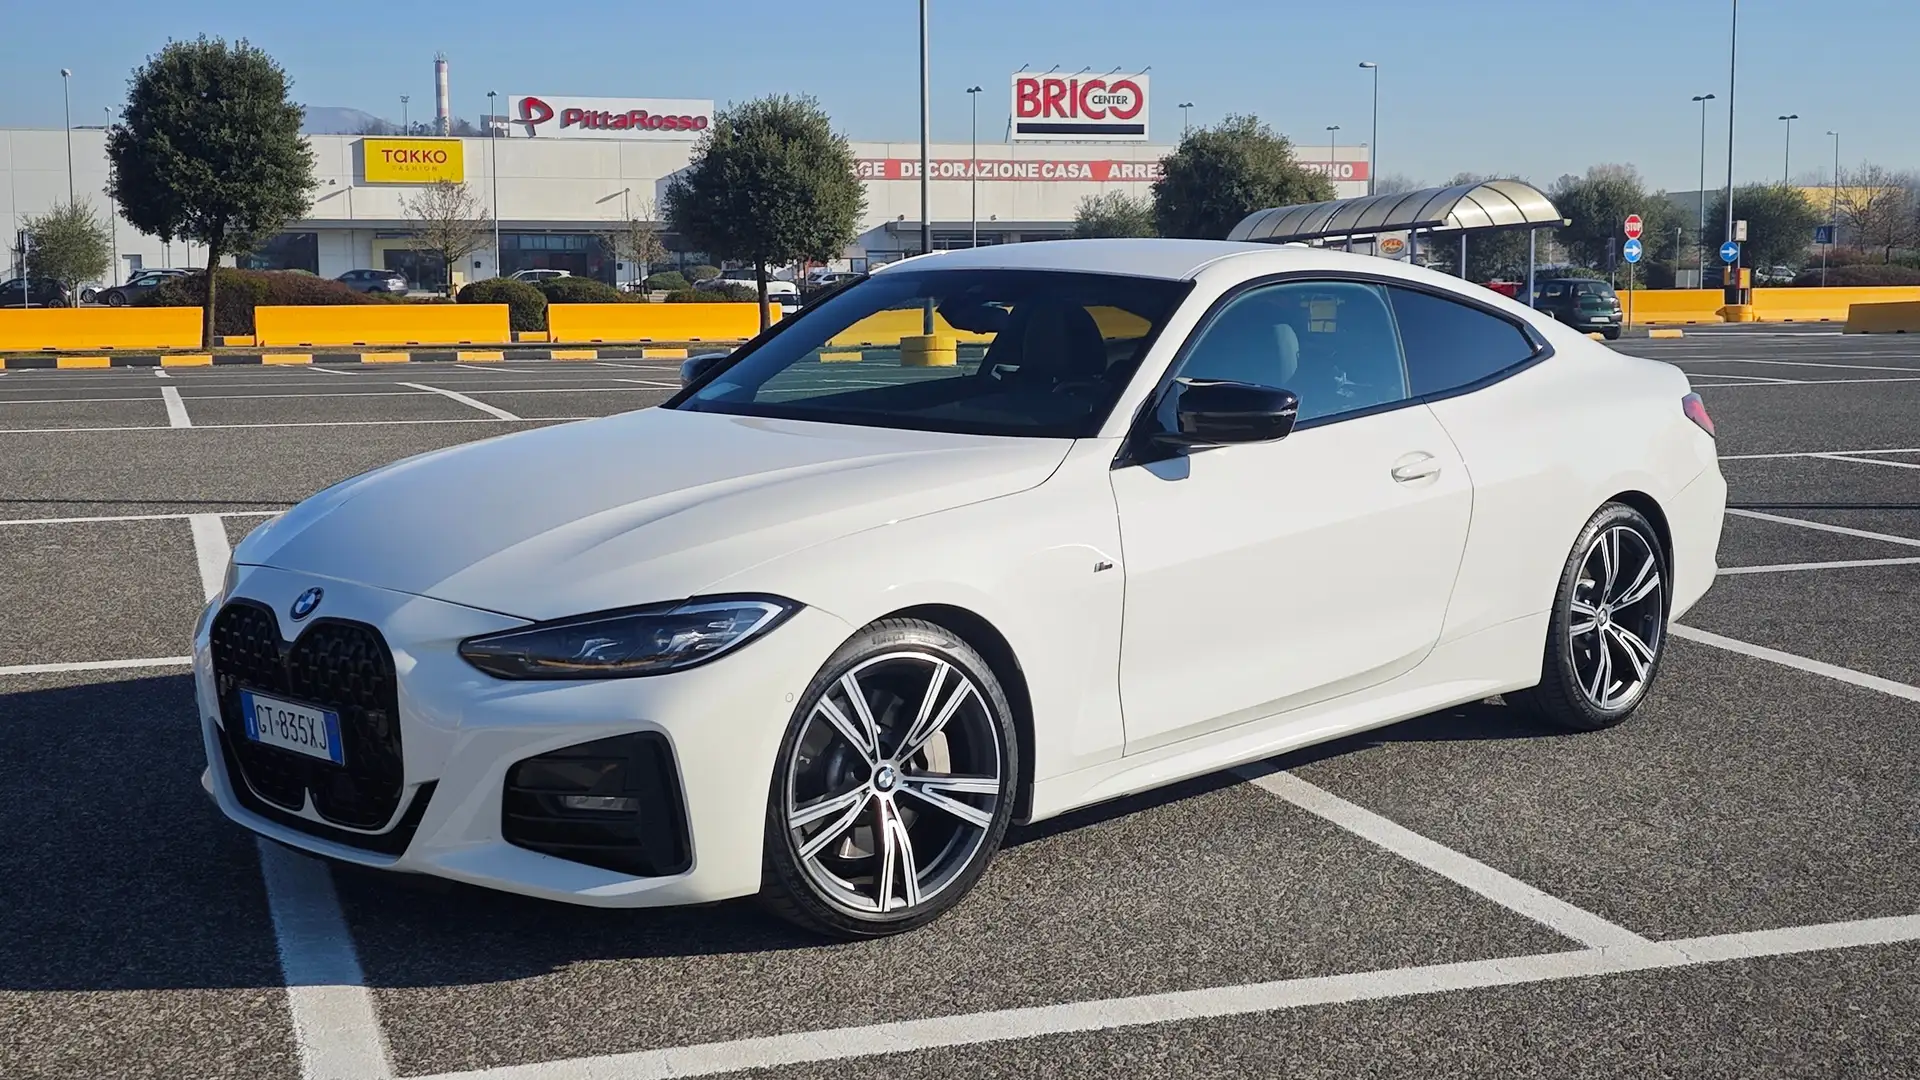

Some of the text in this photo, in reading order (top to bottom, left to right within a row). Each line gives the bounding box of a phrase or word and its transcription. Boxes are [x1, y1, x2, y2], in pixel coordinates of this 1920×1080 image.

[1016, 78, 1144, 120] BRICO
[1092, 95, 1128, 105] CENTER
[560, 108, 708, 131] PittaRosso
[900, 161, 1039, 178] DECORAZIONE
[1041, 163, 1093, 178] CASA
[1626, 222, 1642, 231] STOP
